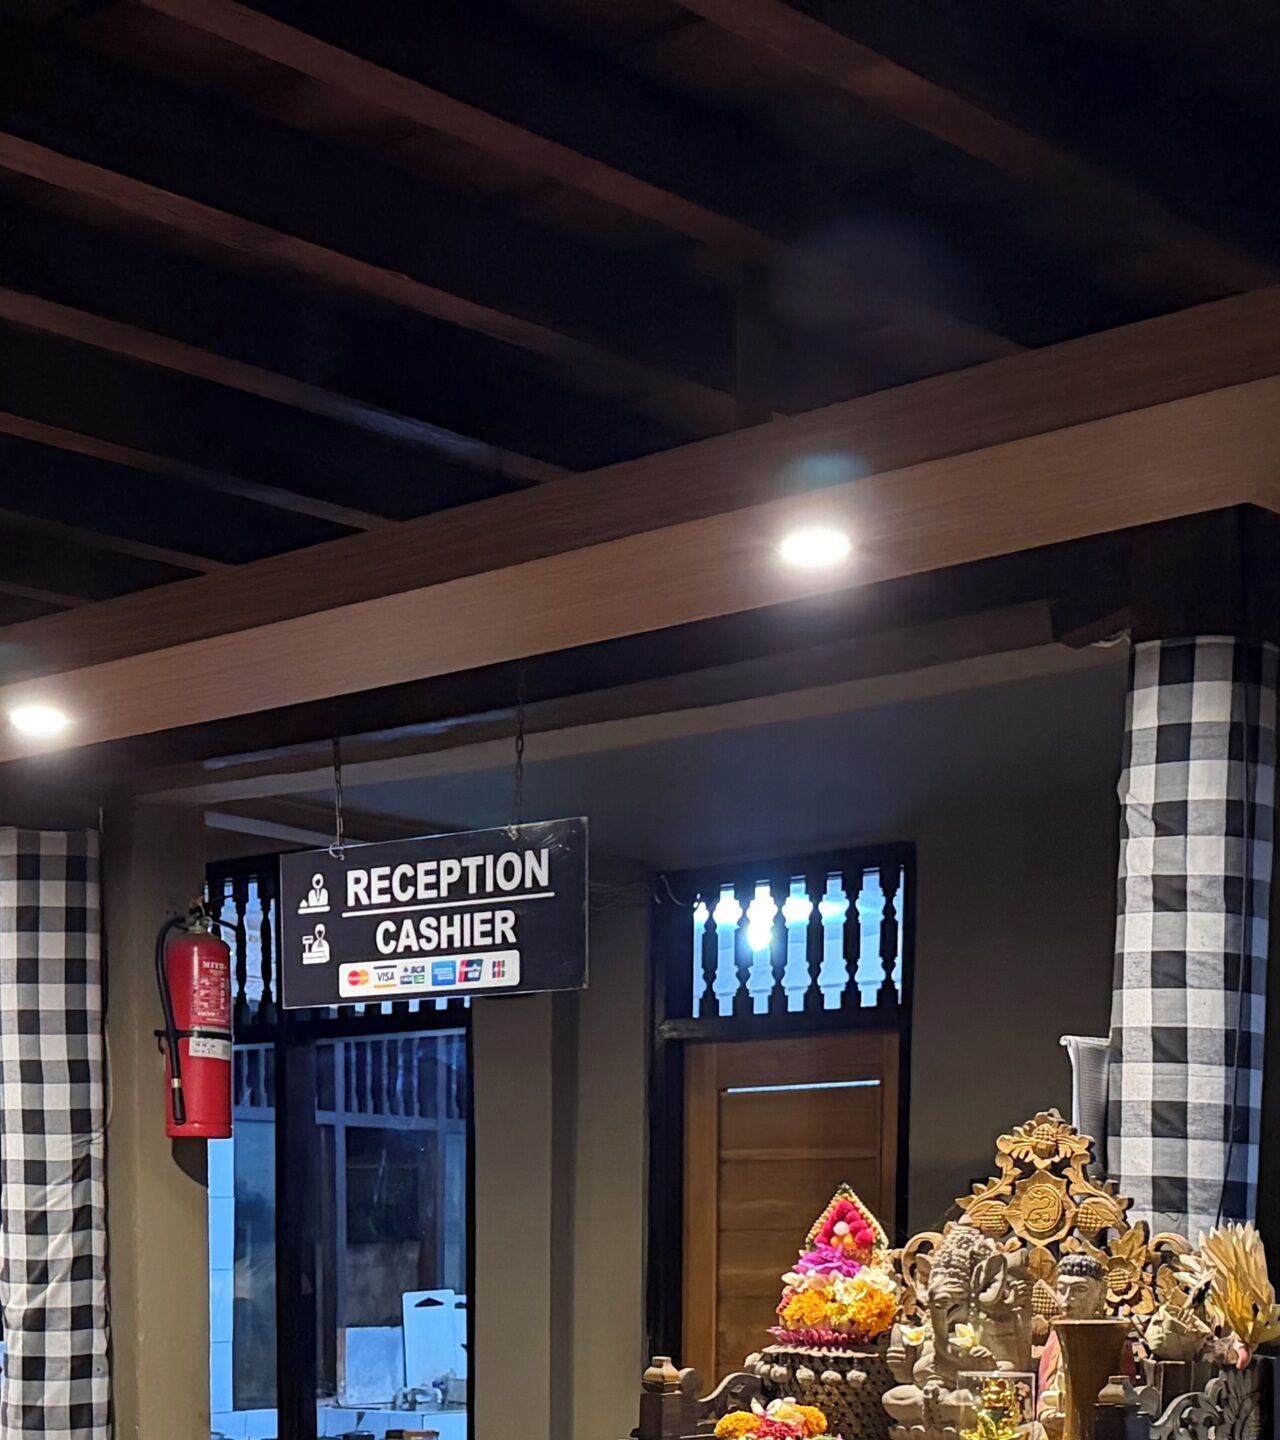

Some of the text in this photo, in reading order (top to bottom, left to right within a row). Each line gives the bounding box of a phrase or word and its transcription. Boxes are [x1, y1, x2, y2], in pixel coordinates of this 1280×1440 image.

[346, 848, 550, 907] RECEPTION
[375, 909, 517, 954] CASHIER
[376, 971, 395, 982] VISA
